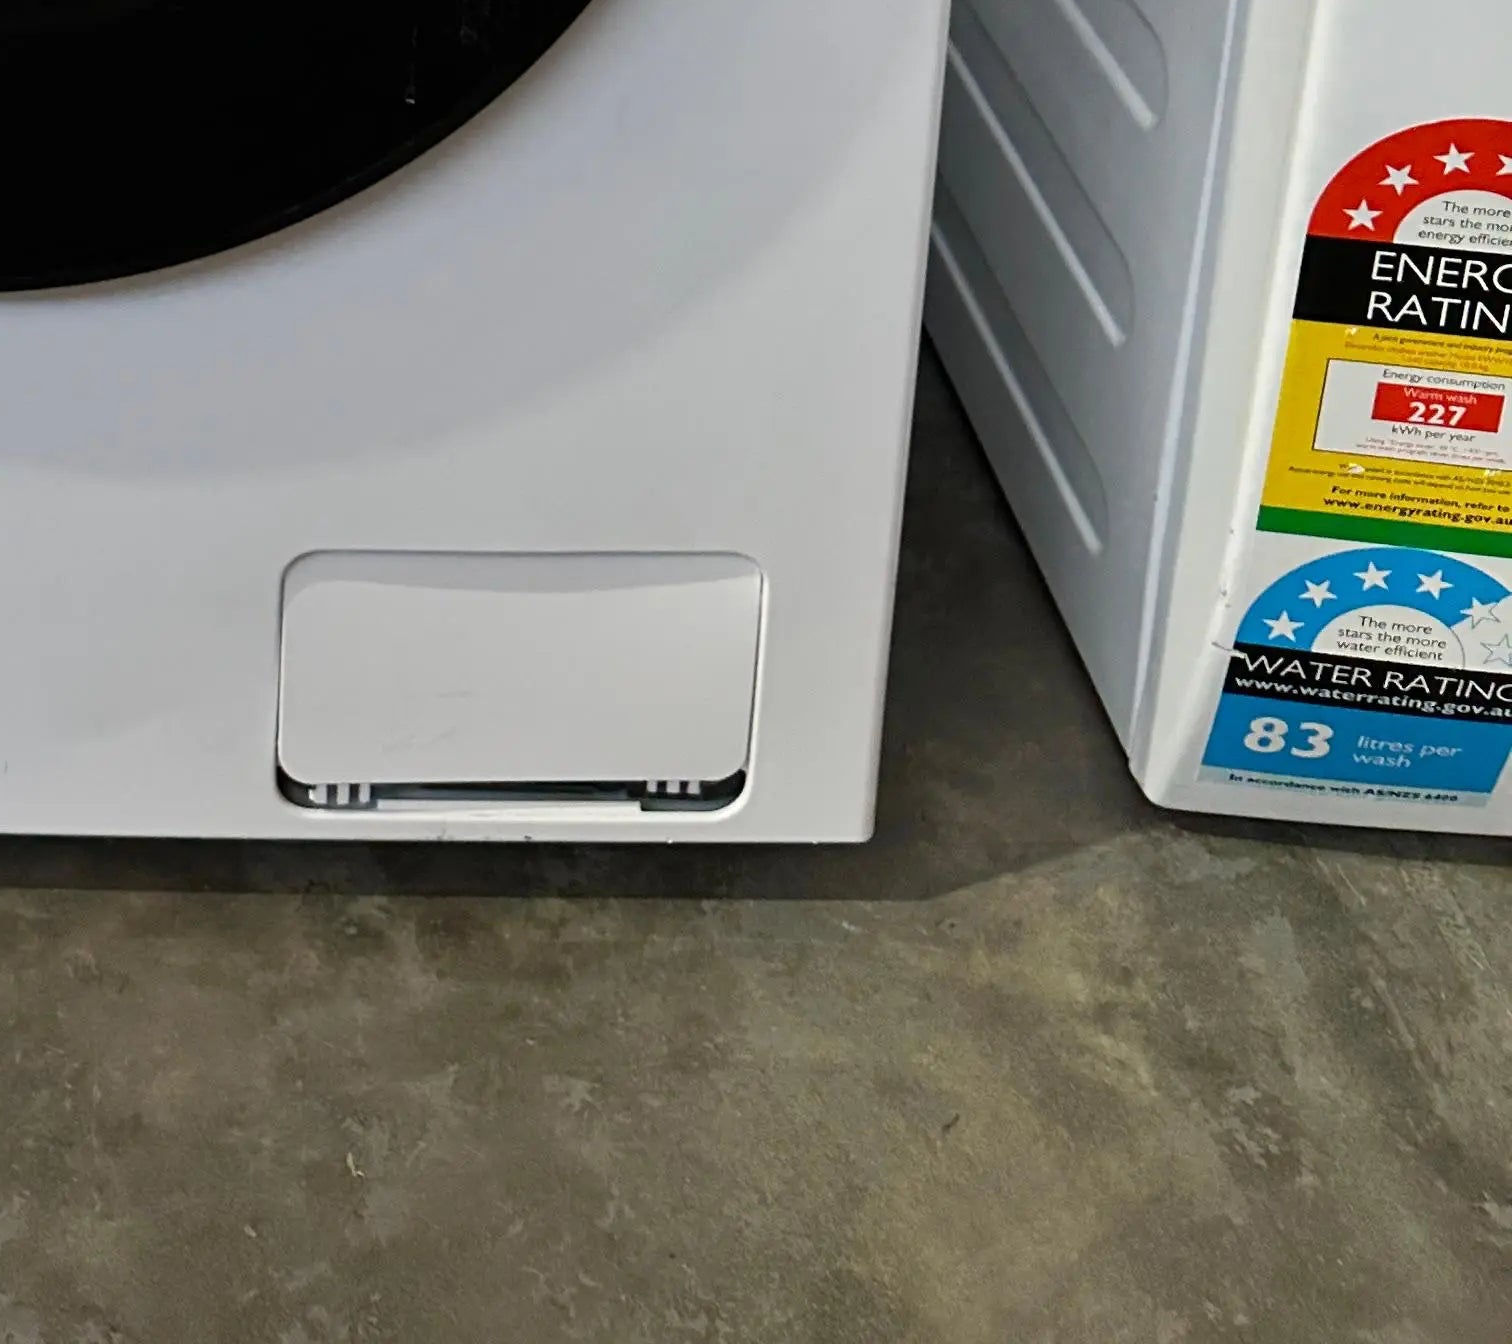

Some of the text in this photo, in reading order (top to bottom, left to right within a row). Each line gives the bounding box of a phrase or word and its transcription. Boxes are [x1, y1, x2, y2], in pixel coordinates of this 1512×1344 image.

[1441, 199, 1511, 219] The more
[1423, 215, 1456, 227] stars
[1460, 217, 1482, 230] the
[1417, 229, 1466, 245] energy
[1366, 290, 1511, 334] RATIN
[1382, 368, 1506, 391] Energy consumption
[1403, 387, 1478, 405] Warm wash
[1408, 400, 1468, 427] 227
[1391, 424, 1476, 443] kWh per year
[1331, 485, 1354, 496] For
[1355, 489, 1387, 500] more
[1464, 501, 1494, 511] refer
[1497, 504, 1510, 513] to
[1359, 615, 1433, 635] The more
[1337, 627, 1447, 649] stars the more
[1336, 639, 1444, 661] water efficient
[1242, 654, 1371, 689] WATER
[1243, 716, 1334, 759] 83
[1357, 735, 1464, 759] litres per
[1352, 751, 1412, 769] wash
